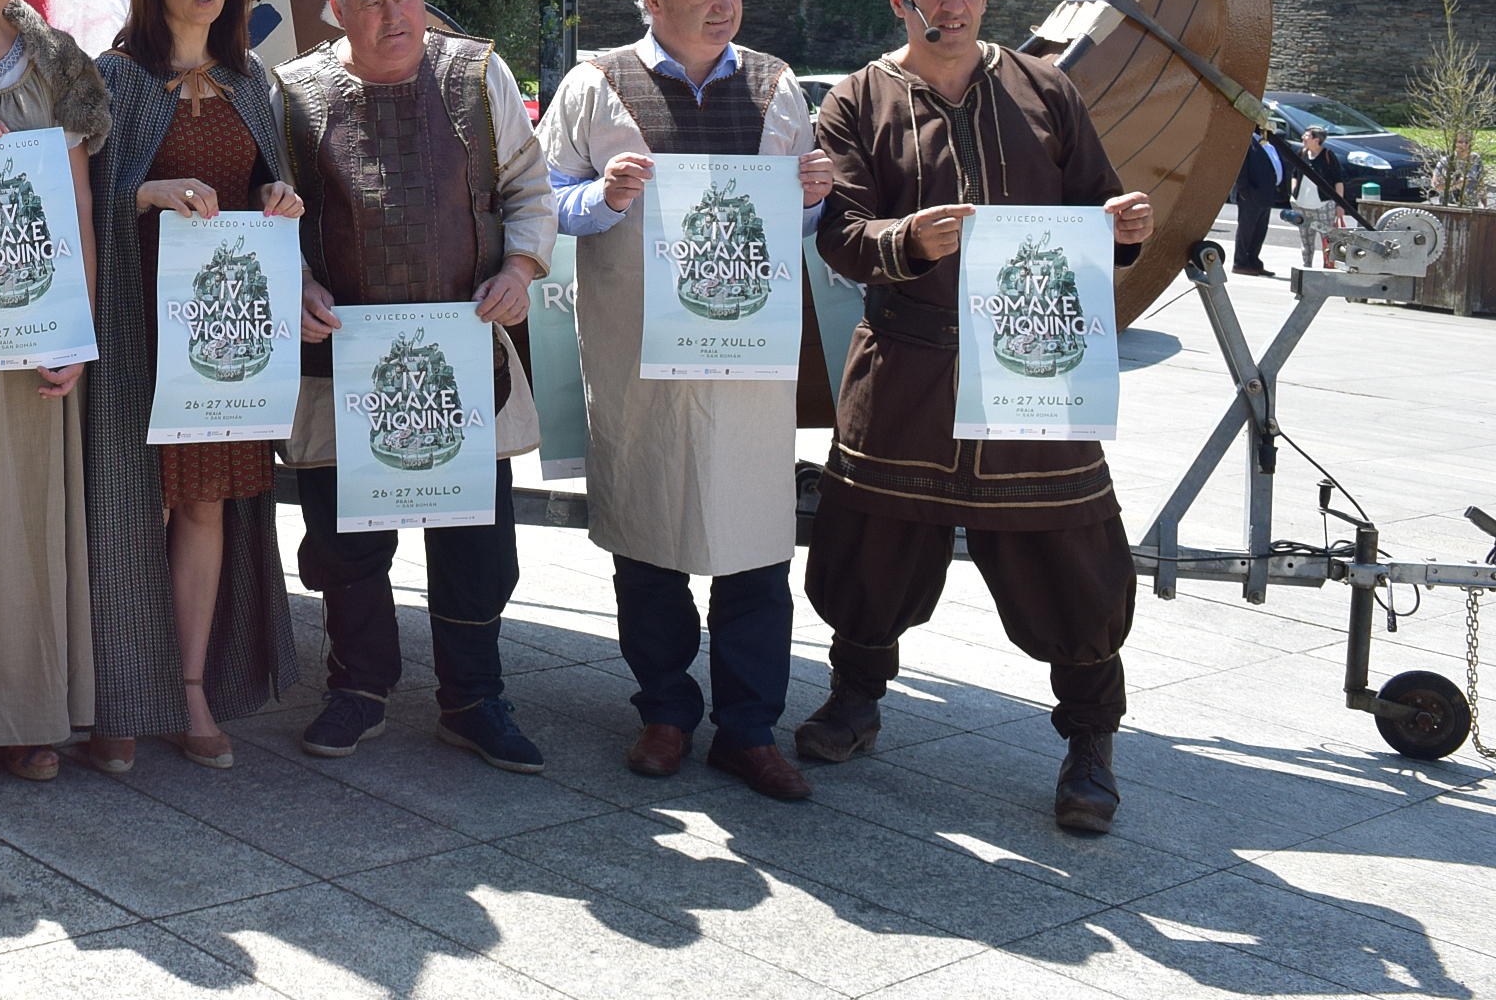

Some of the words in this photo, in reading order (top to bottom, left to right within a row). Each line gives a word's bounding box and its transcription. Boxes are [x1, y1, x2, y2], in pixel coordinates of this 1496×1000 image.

[712, 222, 736, 240] IV
[655, 241, 764, 263] ROMAXE
[676, 261, 792, 280] VIQUINGA
[220, 280, 242, 299] IV
[1026, 275, 1049, 294] IV
[168, 298, 266, 324] ROMAXE
[970, 296, 1077, 318] ROMAXE
[16, 321, 57, 336] XULLO
[187, 320, 291, 339] VIQUINGA
[992, 316, 1105, 336] VIQUINGA
[678, 338, 692, 346] 26
[701, 338, 716, 346] 27
[721, 338, 766, 346] XULLO
[403, 371, 426, 390] IV
[185, 401, 199, 409] 26
[207, 400, 221, 408] 27
[225, 399, 266, 408] XULLO
[345, 390, 455, 415] ROMAXE
[993, 396, 1008, 404] 26
[1017, 396, 1032, 405] 27
[1038, 396, 1084, 406] XULLO
[368, 409, 484, 431] VIQUINGA
[372, 490, 387, 498] 26
[396, 488, 411, 497] 27
[416, 486, 461, 496] XULLO
